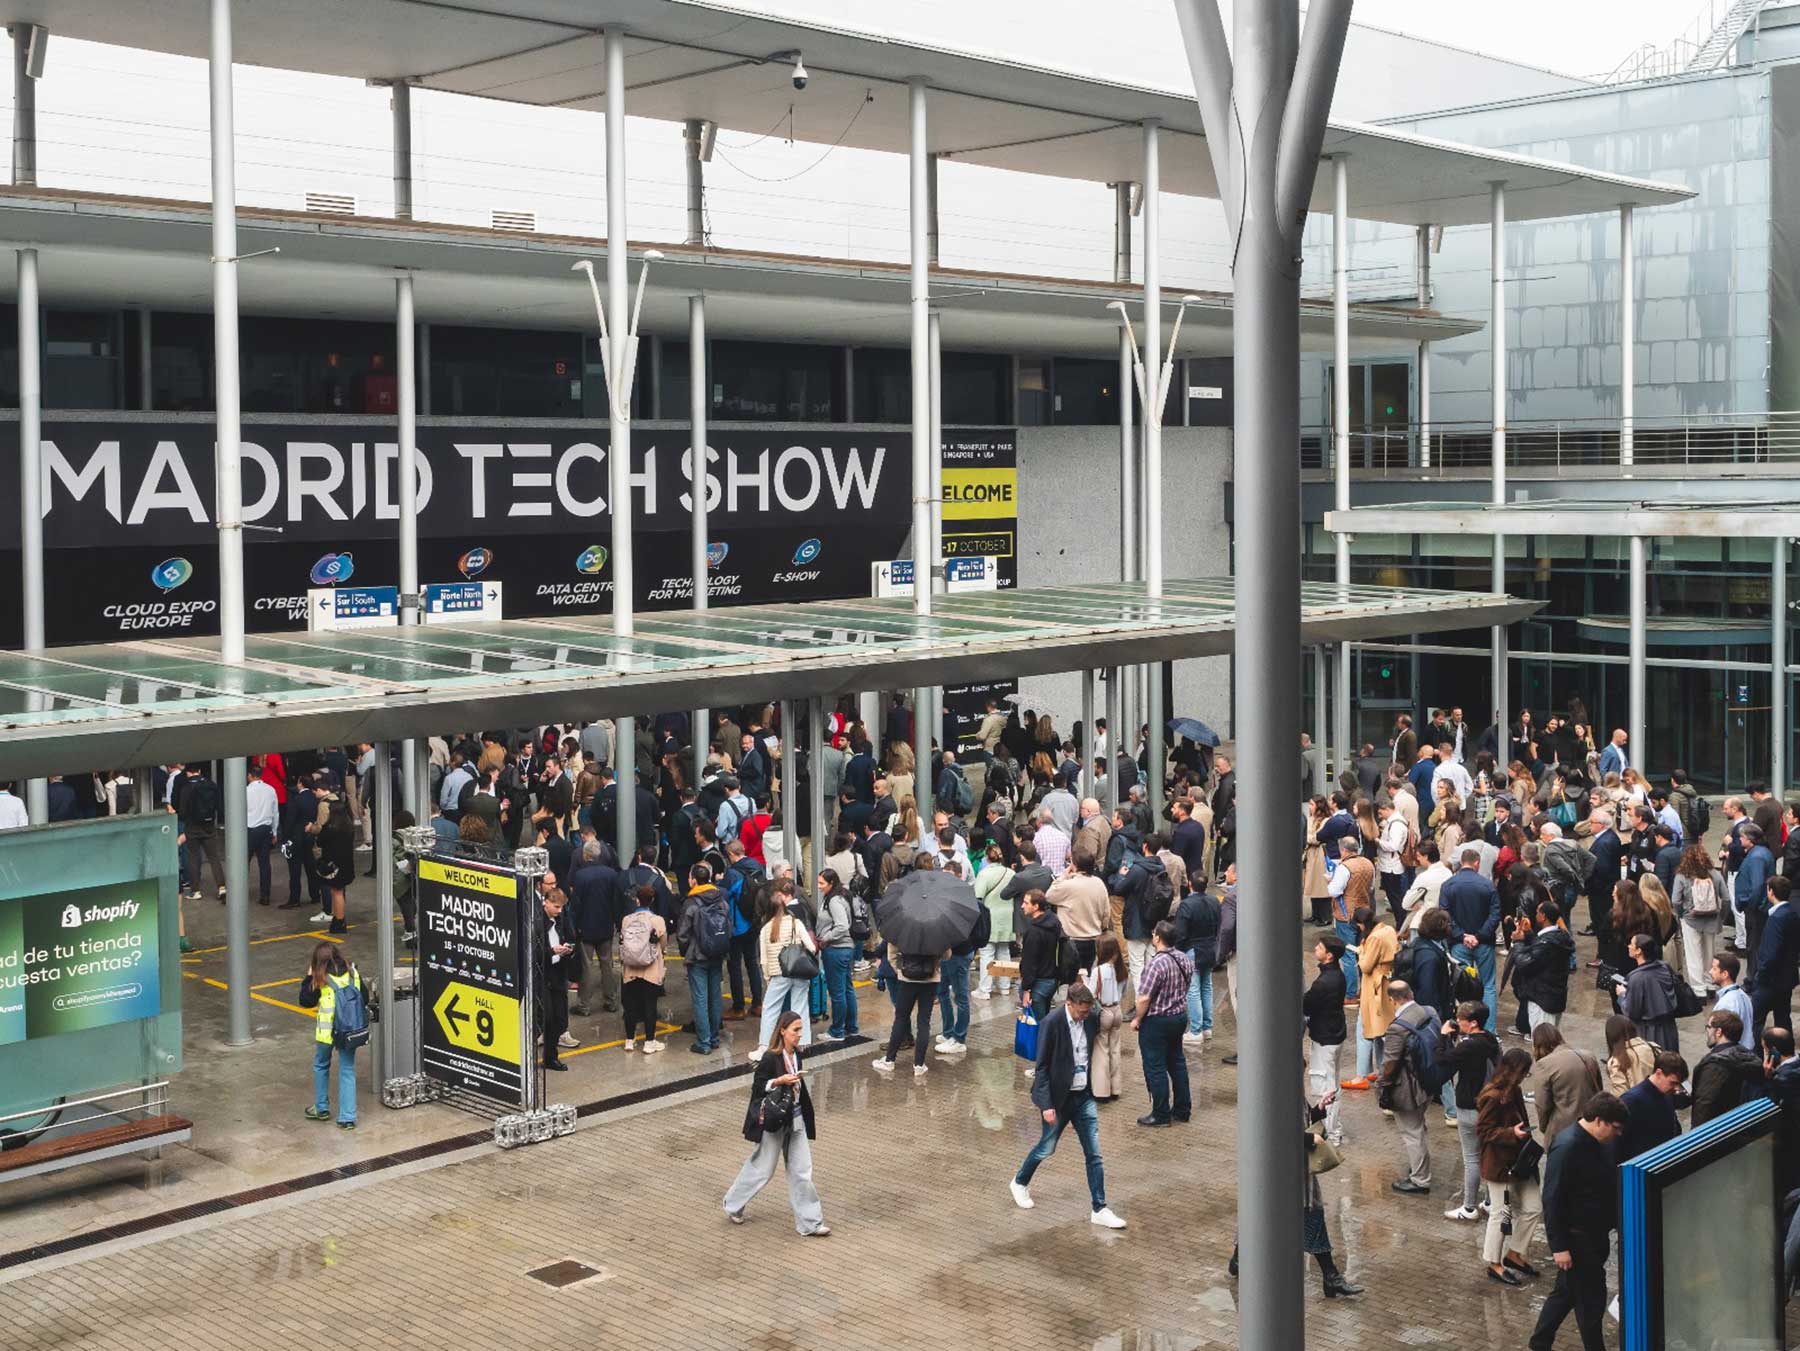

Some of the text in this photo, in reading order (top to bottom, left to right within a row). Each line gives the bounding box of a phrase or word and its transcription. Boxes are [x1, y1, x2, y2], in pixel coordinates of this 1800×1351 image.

[40, 440, 886, 525] MADRID TECH SHOW
[960, 539, 1006, 552] OCTOBER
[772, 570, 821, 583] E-SHOW
[440, 590, 482, 600] Norte North
[536, 583, 571, 595] DATA
[647, 588, 674, 600] FOR
[355, 595, 376, 605] South
[552, 593, 600, 605] WORLD
[103, 600, 216, 618] CLOUD EXPO
[119, 614, 193, 630] EUROPE
[444, 864, 490, 889] WELCOME
[84, 899, 140, 923] shopify
[441, 893, 495, 922] MADRID
[425, 910, 511, 948] TECH SHOW
[23, 946, 49, 965] de
[53, 944, 75, 959] tu
[80, 932, 142, 955] tienda
[464, 945, 495, 961] OCTOBER
[66, 950, 143, 977] ventas?
[475, 996, 495, 1010] HALL
[476, 1009, 494, 1047] 9
